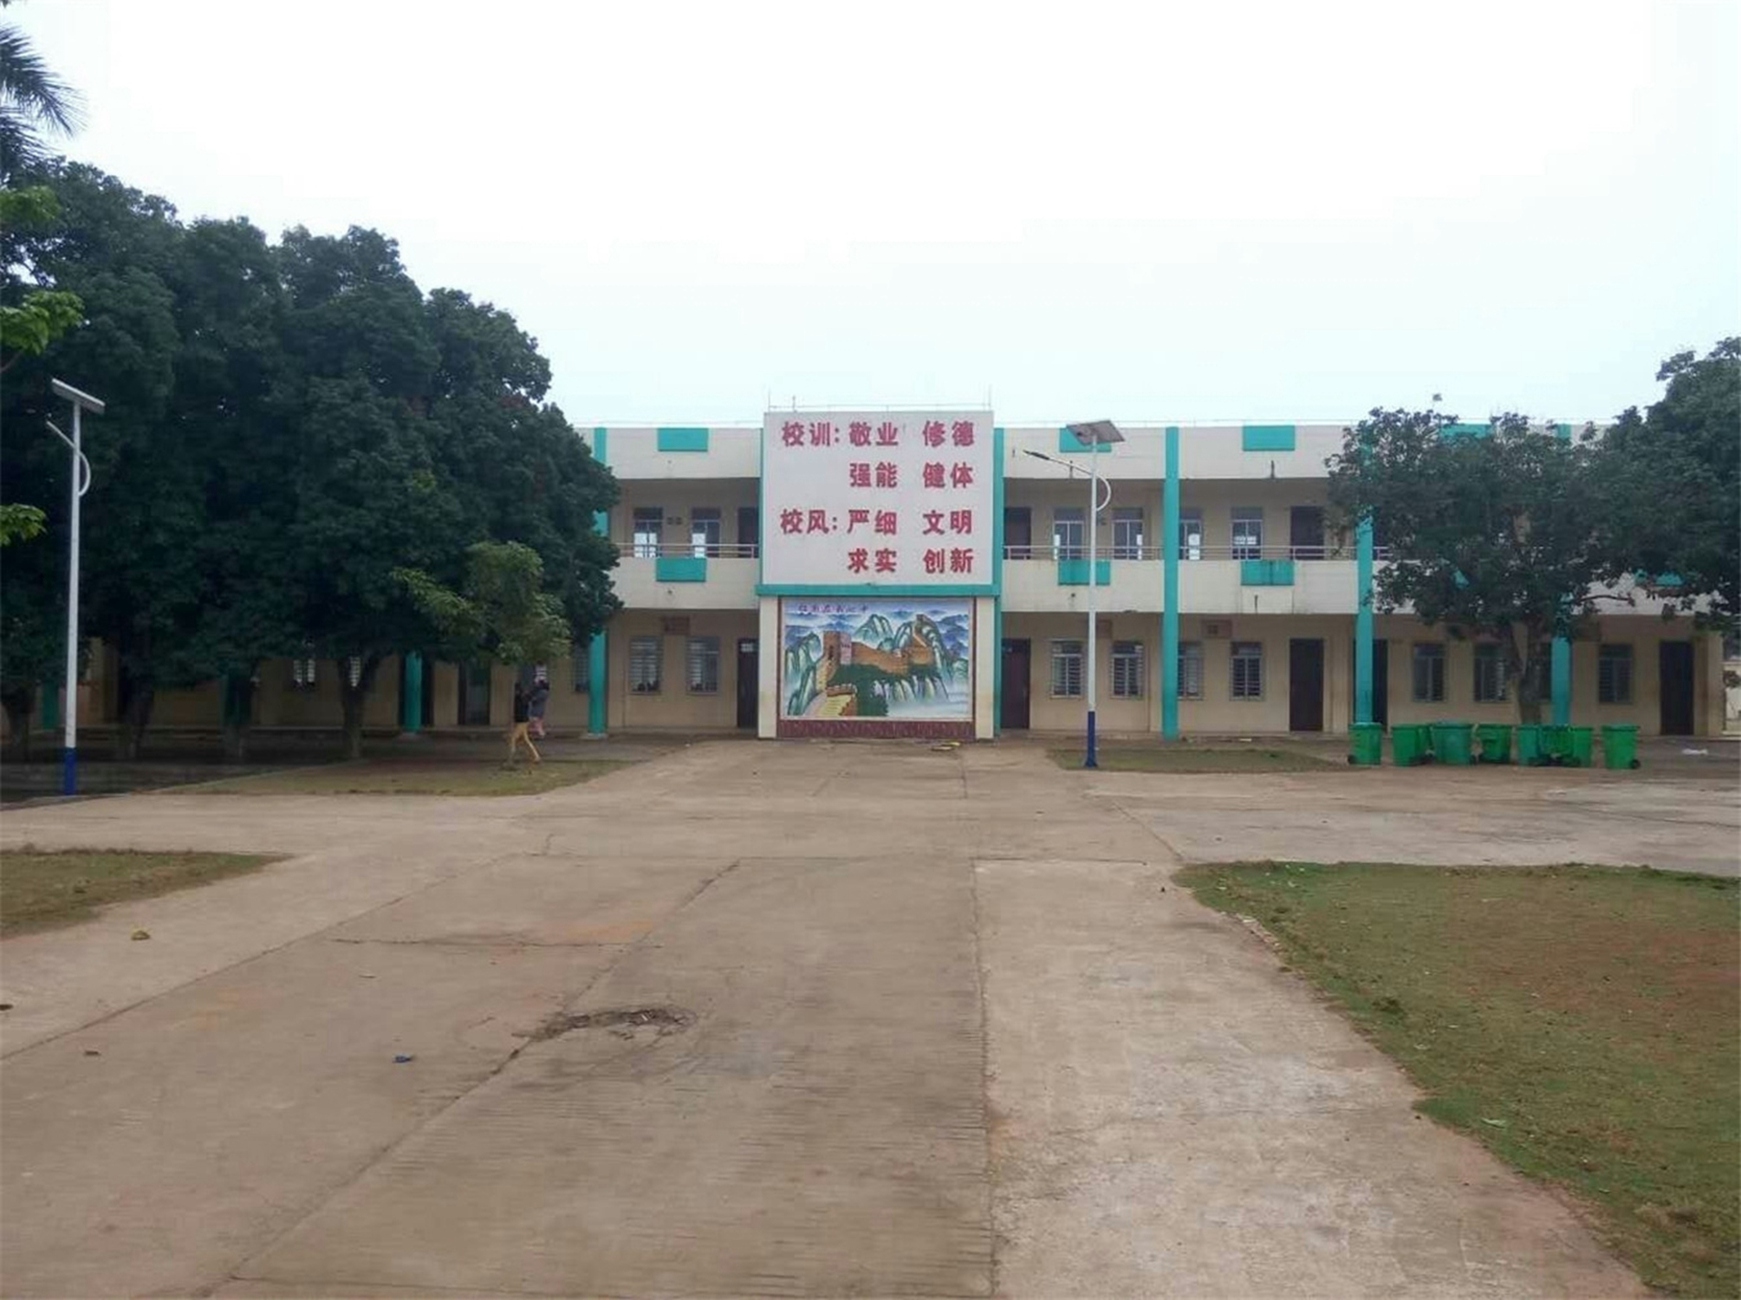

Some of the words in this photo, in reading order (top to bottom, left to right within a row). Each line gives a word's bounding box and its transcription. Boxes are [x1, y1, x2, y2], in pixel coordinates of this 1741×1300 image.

[922, 420, 975, 447] 修德
[849, 462, 898, 489] 强能
[922, 462, 974, 489] 健体
[922, 509, 973, 535] 文明
[847, 548, 898, 574] 求实
[922, 548, 974, 574] 创新
